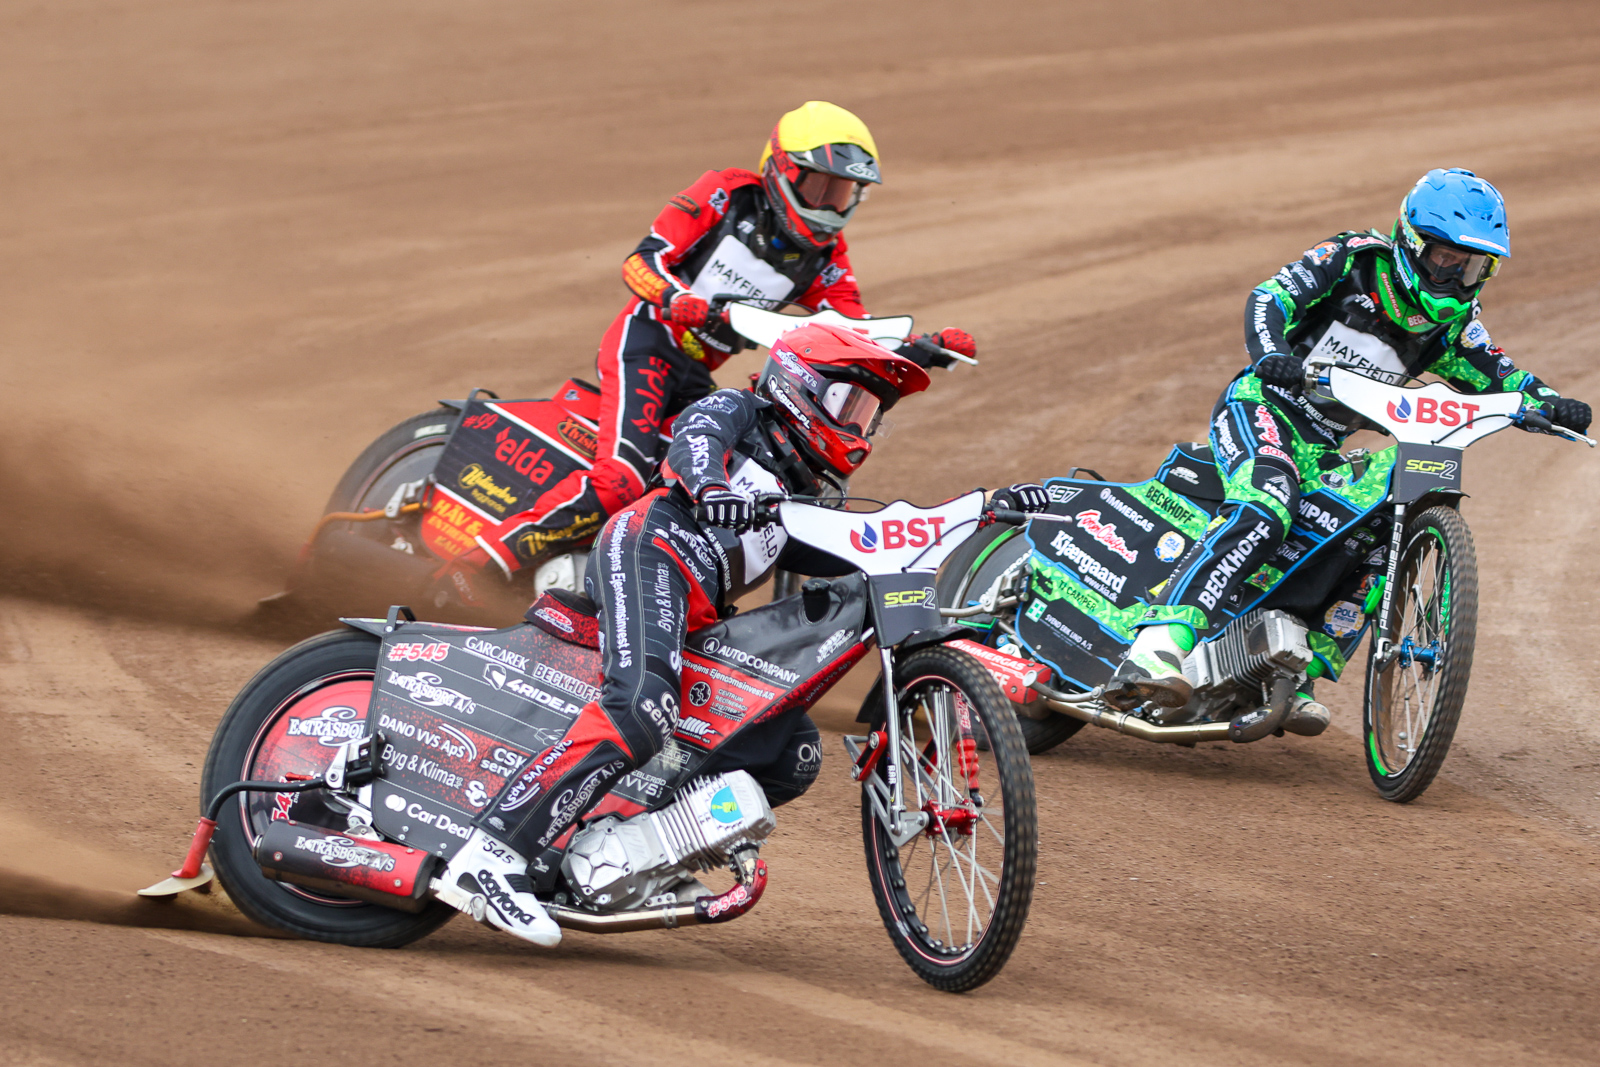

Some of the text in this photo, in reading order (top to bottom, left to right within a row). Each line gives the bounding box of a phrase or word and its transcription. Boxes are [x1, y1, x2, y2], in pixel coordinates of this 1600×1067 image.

[711, 259, 775, 309] MAYFIELD
[1254, 300, 1277, 353] IMMERGAS
[1324, 336, 1394, 384] MAYFIELD
[462, 413, 499, 430] #99
[774, 389, 811, 430] 4RIDE.PL
[1296, 396, 1308, 407] 97
[1303, 402, 1324, 422] MIKKEL
[1321, 417, 1349, 432] ANDERSEN
[1415, 397, 1481, 429] BST
[495, 437, 555, 485] elda
[1405, 459, 1459, 481] SGP2
[1107, 494, 1156, 533] IMMERGAS
[1146, 481, 1196, 525] BECKHOFF
[464, 519, 484, 538] &
[882, 516, 946, 550] BST
[703, 526, 718, 546] 545
[714, 541, 730, 571] WILLIAM
[1050, 530, 1128, 594] Kjærgaard
[1198, 520, 1272, 611] BECKHOFF
[654, 564, 672, 599] Klima
[684, 557, 707, 584] Deal
[1379, 520, 1404, 631] ceramicspeed
[608, 573, 631, 650] Ejendomsinvest
[656, 594, 673, 608] &
[884, 586, 937, 610] SGP2
[1066, 584, 1097, 613] CAMPER
[1335, 606, 1359, 618] POLE
[656, 607, 676, 632] Byg
[387, 643, 450, 662] #545
[464, 636, 530, 672] GARCAREK
[618, 650, 632, 668] A/S
[717, 645, 801, 684] AUTOCOMPANY
[958, 642, 1026, 672] IMMERGAS
[506, 678, 583, 715] 4RIDE.P
[532, 663, 602, 703] BECKHOFF
[709, 667, 764, 699] Ejendomsinvest
[452, 696, 477, 715] A/S
[640, 697, 674, 739] serv
[660, 691, 680, 724] CS
[378, 714, 466, 760] DANO VVS ApS
[542, 739, 574, 766] DANO
[381, 743, 406, 771] Byg
[406, 754, 420, 771] &
[419, 757, 457, 787] Klima
[522, 764, 548, 783] VVS
[601, 759, 625, 780] A/S
[506, 781, 527, 803] ApS
[406, 804, 474, 841] Car Deal
[372, 855, 397, 873] A/S
[481, 840, 516, 865] 545
[476, 868, 537, 928] daytona
[707, 884, 749, 918] #545
